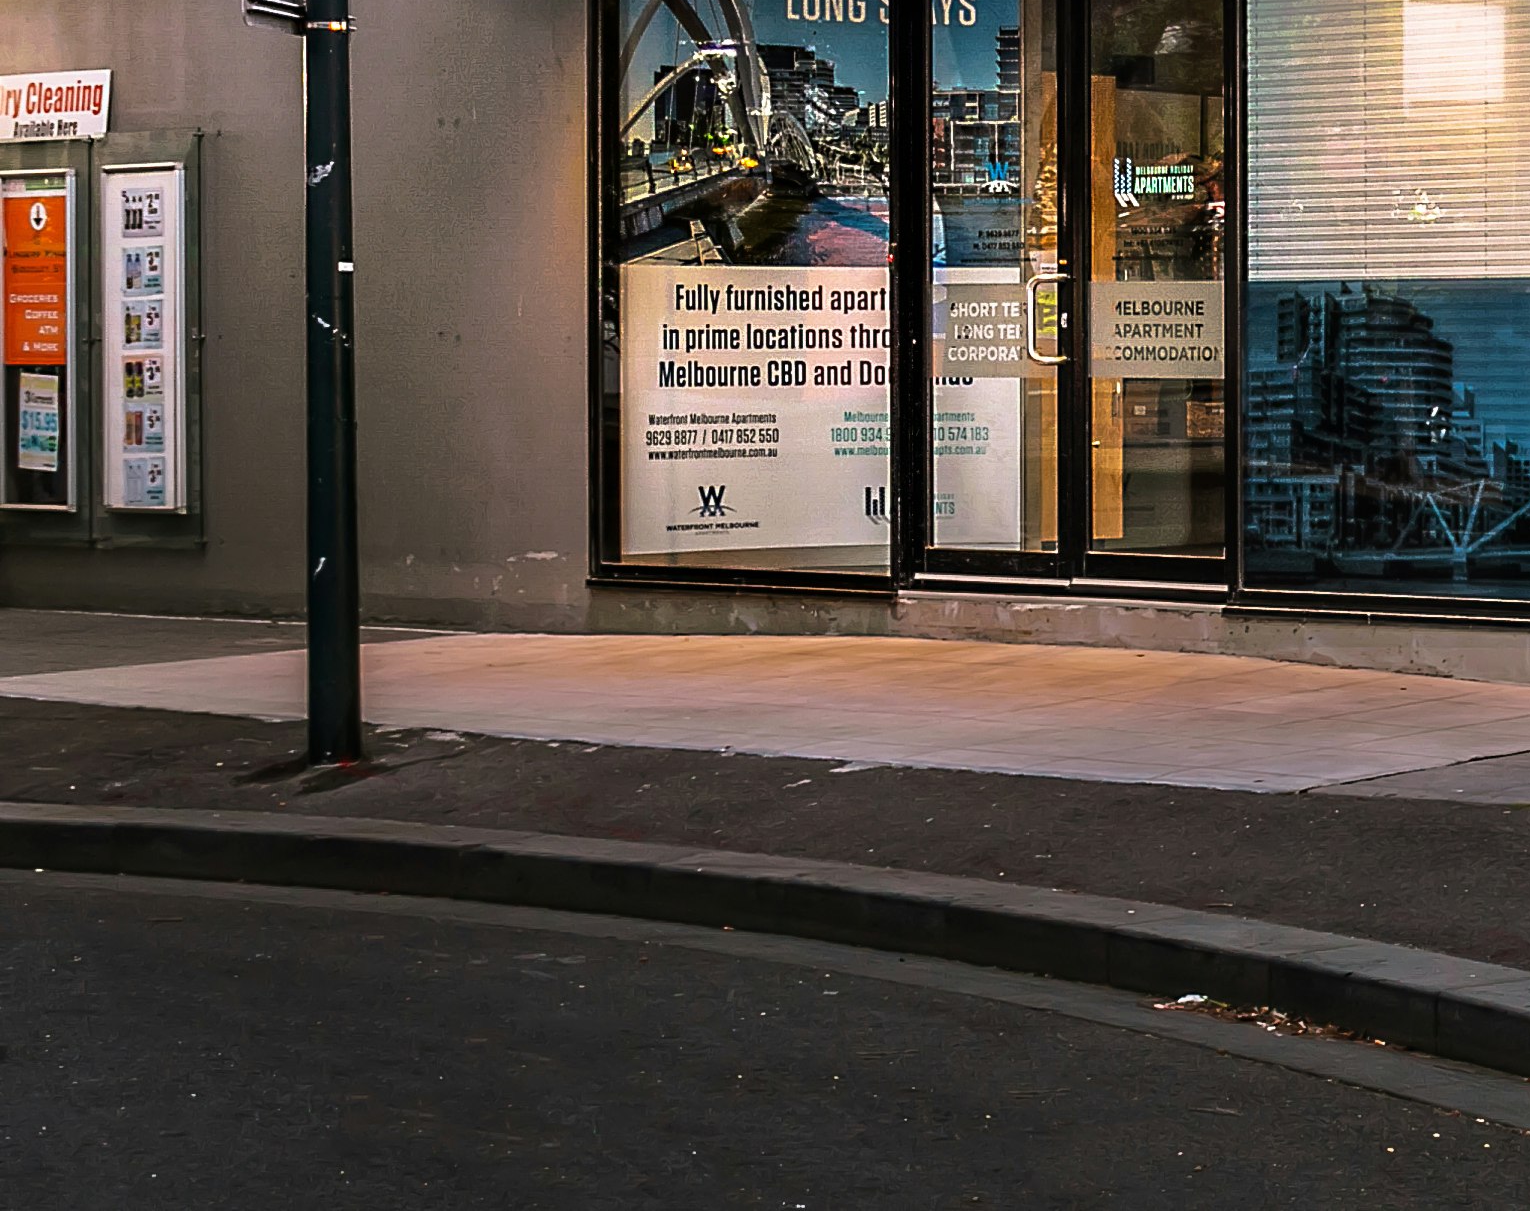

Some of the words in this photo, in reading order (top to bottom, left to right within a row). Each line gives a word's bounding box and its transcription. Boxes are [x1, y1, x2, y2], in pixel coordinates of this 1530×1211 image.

[26, 79, 103, 116] Cleaning
[14, 119, 55, 137] Available
[57, 119, 78, 137] Here
[1134, 176, 1195, 194] APARTMENTS
[675, 283, 720, 315] Fully
[725, 284, 824, 311] furnished
[830, 285, 890, 315] apart
[25, 309, 59, 320] COFFEE
[950, 302, 998, 318] SHORT
[663, 323, 680, 350] in
[685, 323, 741, 354] prime
[746, 323, 843, 350] locations
[954, 325, 994, 340] LONG
[1114, 323, 1204, 338] APARTMENT
[659, 360, 761, 388] Melbourne
[767, 360, 807, 387] CBD
[813, 360, 850, 386] and
[648, 413, 688, 426] Waterfront
[689, 413, 730, 425] Melbourne
[731, 412, 777, 424] Apartments
[646, 430, 672, 446] 9629
[674, 429, 698, 446] 8877
[702, 429, 707, 445] /
[711, 429, 733, 445] 0417
[736, 428, 756, 444] 852
[758, 428, 779, 444] 550
[831, 427, 857, 443] 1800
[861, 427, 882, 443] 934
[948, 427, 967, 442] 574
[970, 427, 989, 441] 183
[666, 523, 714, 532] WATERFRONT
[715, 521, 759, 530] MELBOURNE
